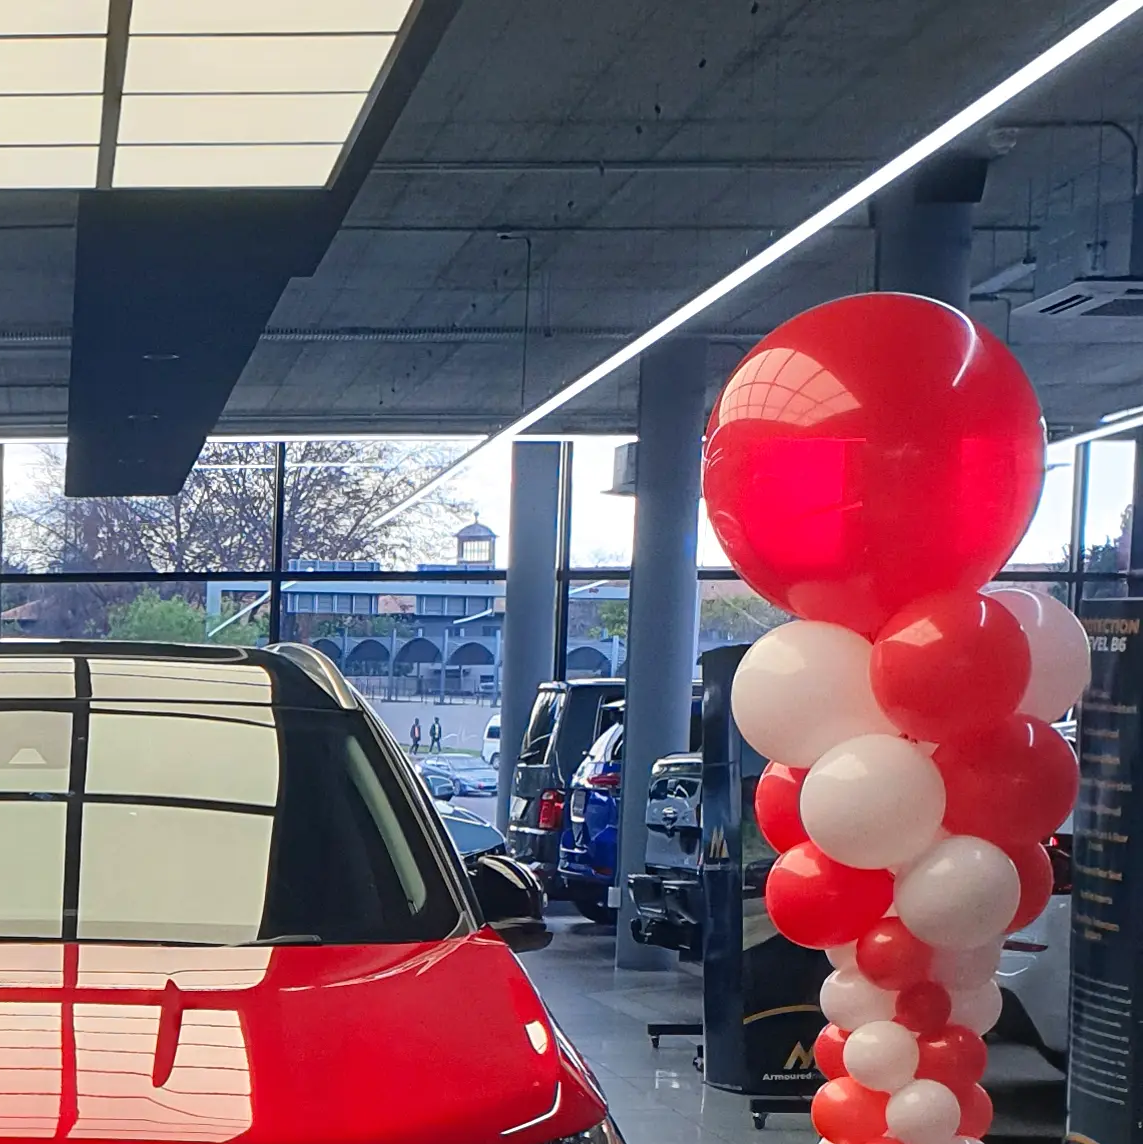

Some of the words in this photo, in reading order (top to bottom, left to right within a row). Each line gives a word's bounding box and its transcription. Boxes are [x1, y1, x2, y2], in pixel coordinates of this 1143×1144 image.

[1088, 636, 1108, 651] EVEL
[1111, 636, 1127, 652] B6
[762, 1071, 812, 1081] Armoured
